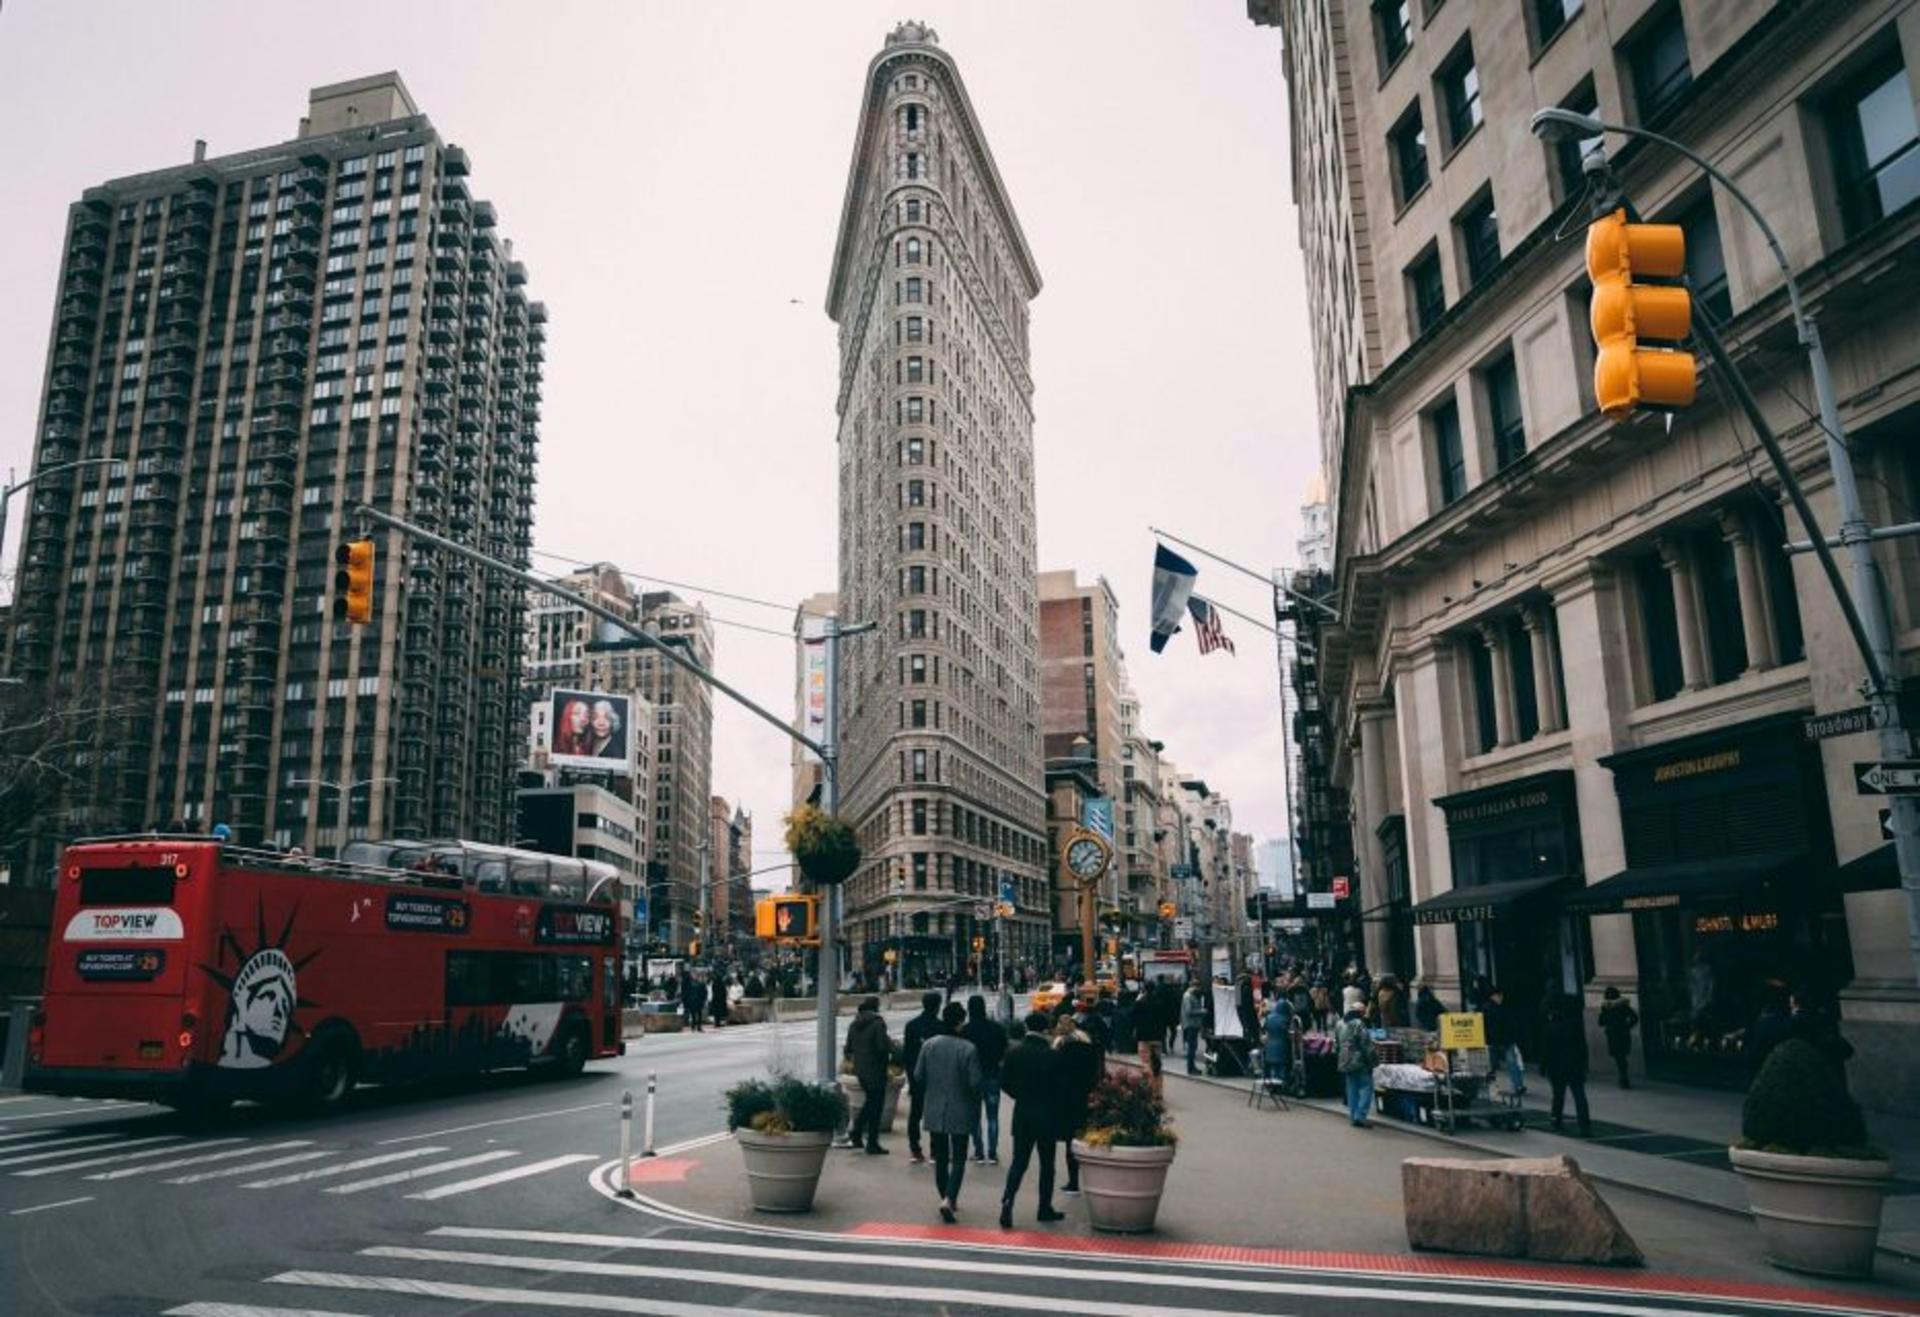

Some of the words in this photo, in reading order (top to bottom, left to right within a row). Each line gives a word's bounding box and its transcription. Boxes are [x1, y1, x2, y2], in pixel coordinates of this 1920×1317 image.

[1805, 714, 1867, 738] Broadway
[1871, 771, 1900, 785] ONE
[161, 853, 179, 865] 317
[93, 914, 158, 929] TOPVIEW
